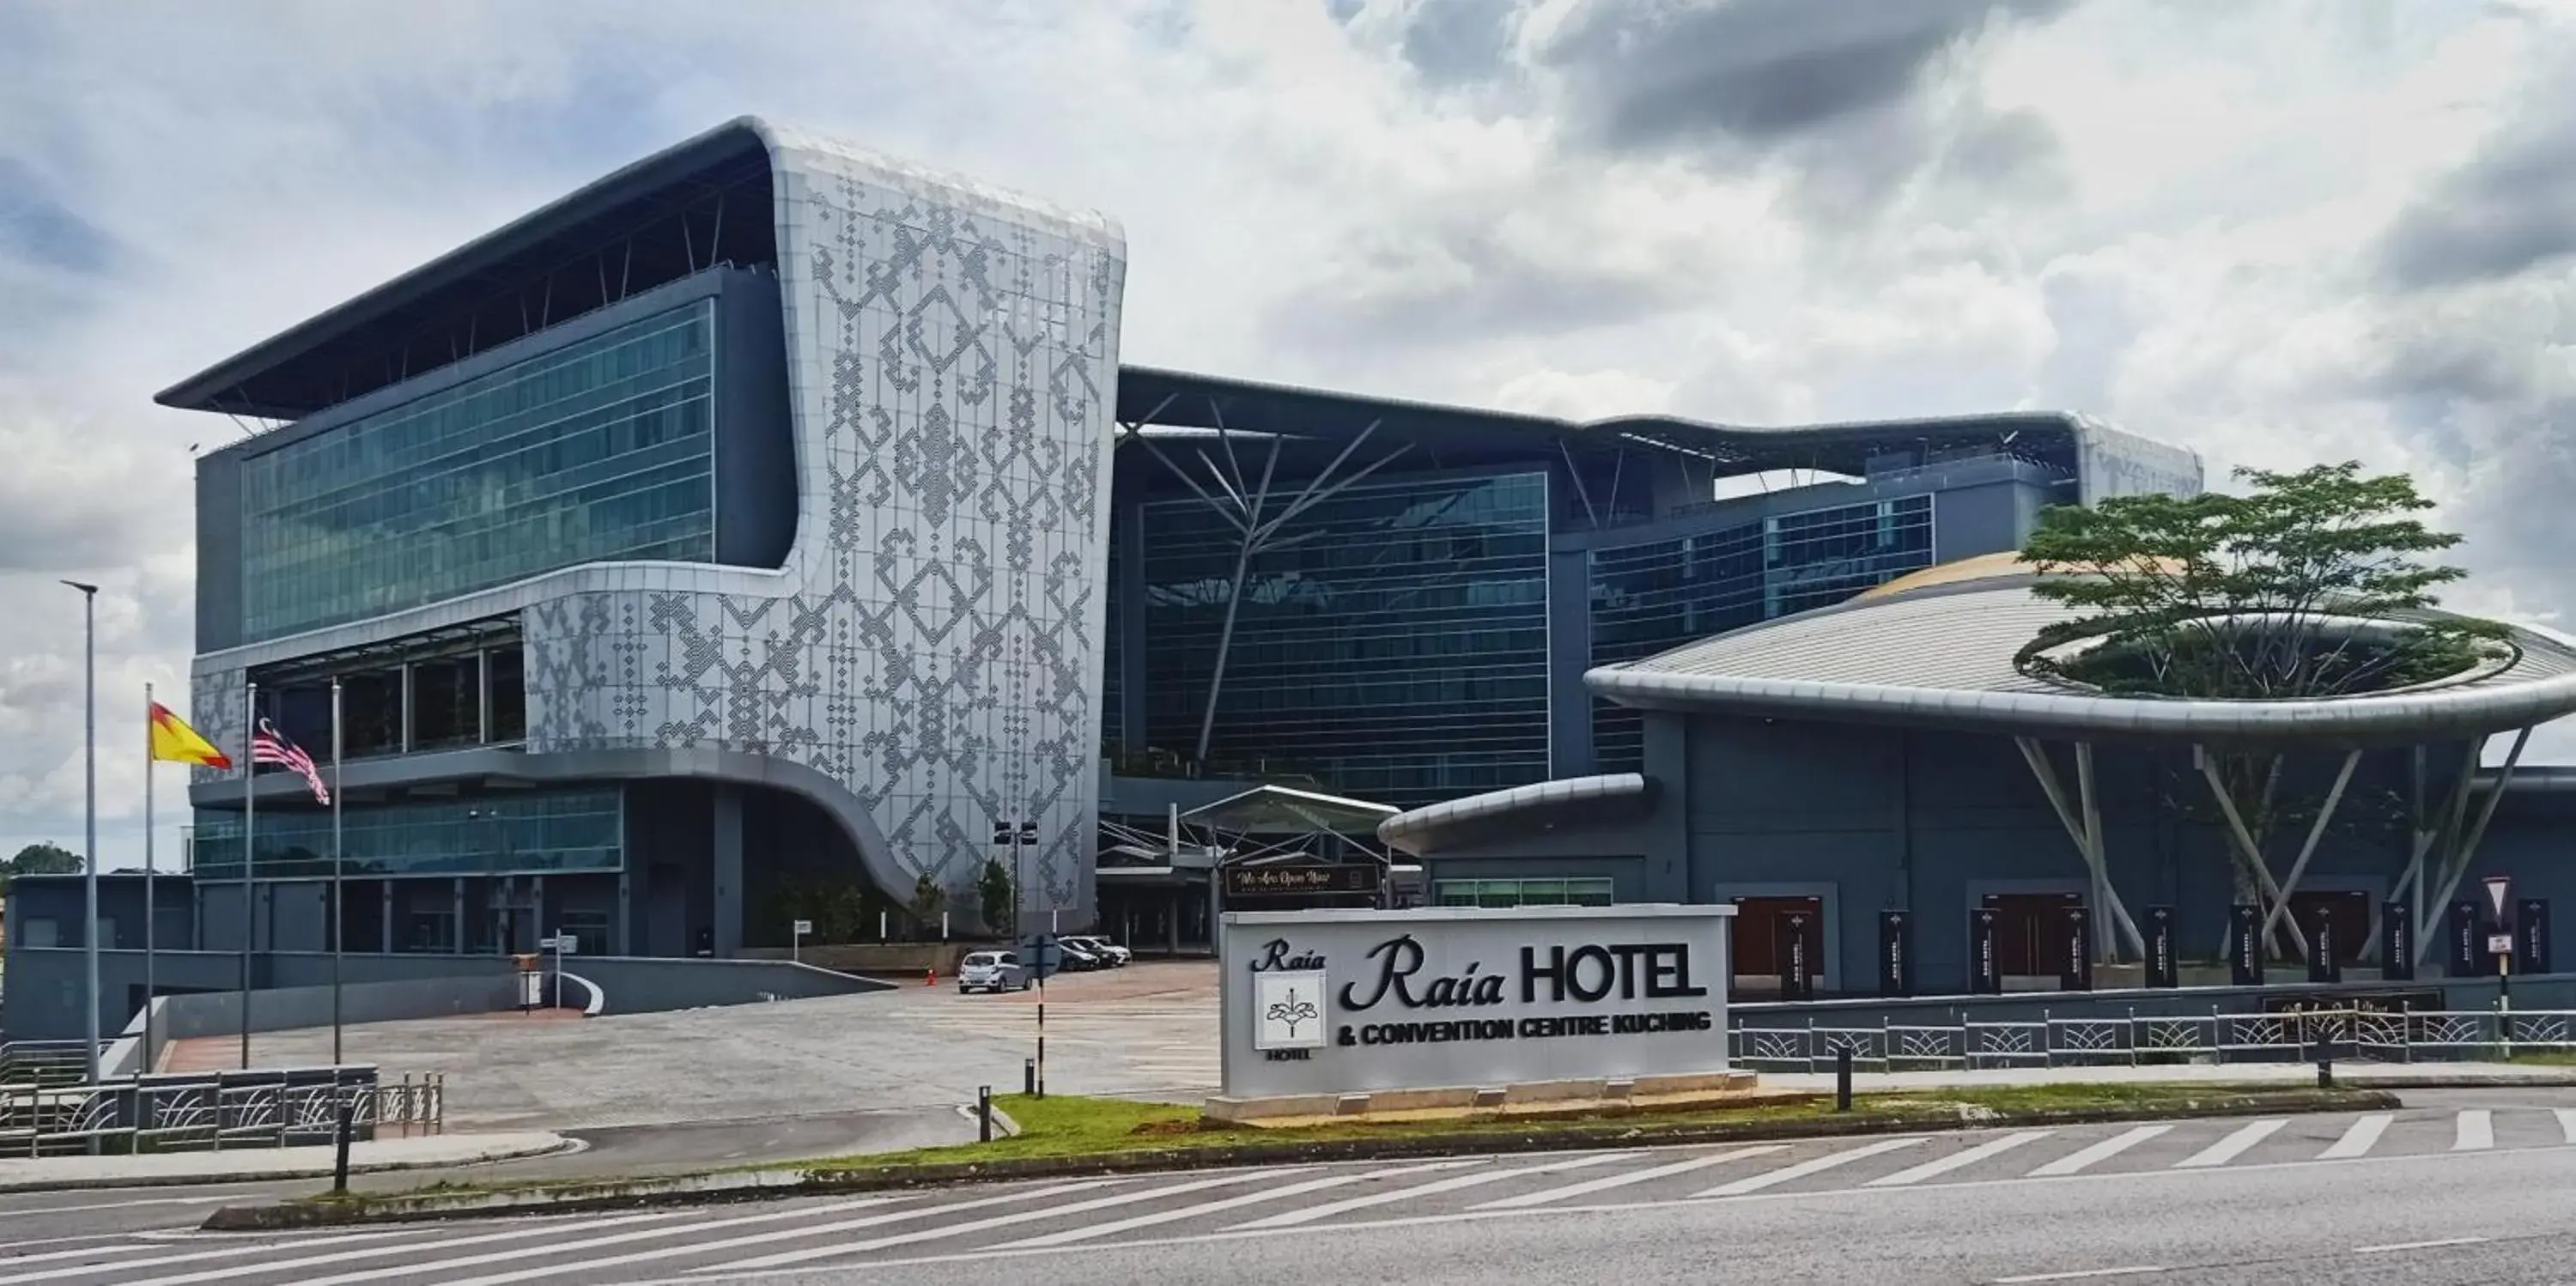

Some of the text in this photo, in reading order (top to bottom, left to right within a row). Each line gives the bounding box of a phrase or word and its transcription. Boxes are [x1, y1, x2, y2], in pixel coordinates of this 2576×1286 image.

[1279, 871, 1305, 886] Open
[1250, 938, 1326, 971] Raia
[1340, 934, 1707, 1011] Raia HOTEL
[1338, 1012, 1711, 1046] & CONVENTION CENTRE KUCHING
[1267, 1049, 1310, 1061] HOTEL
